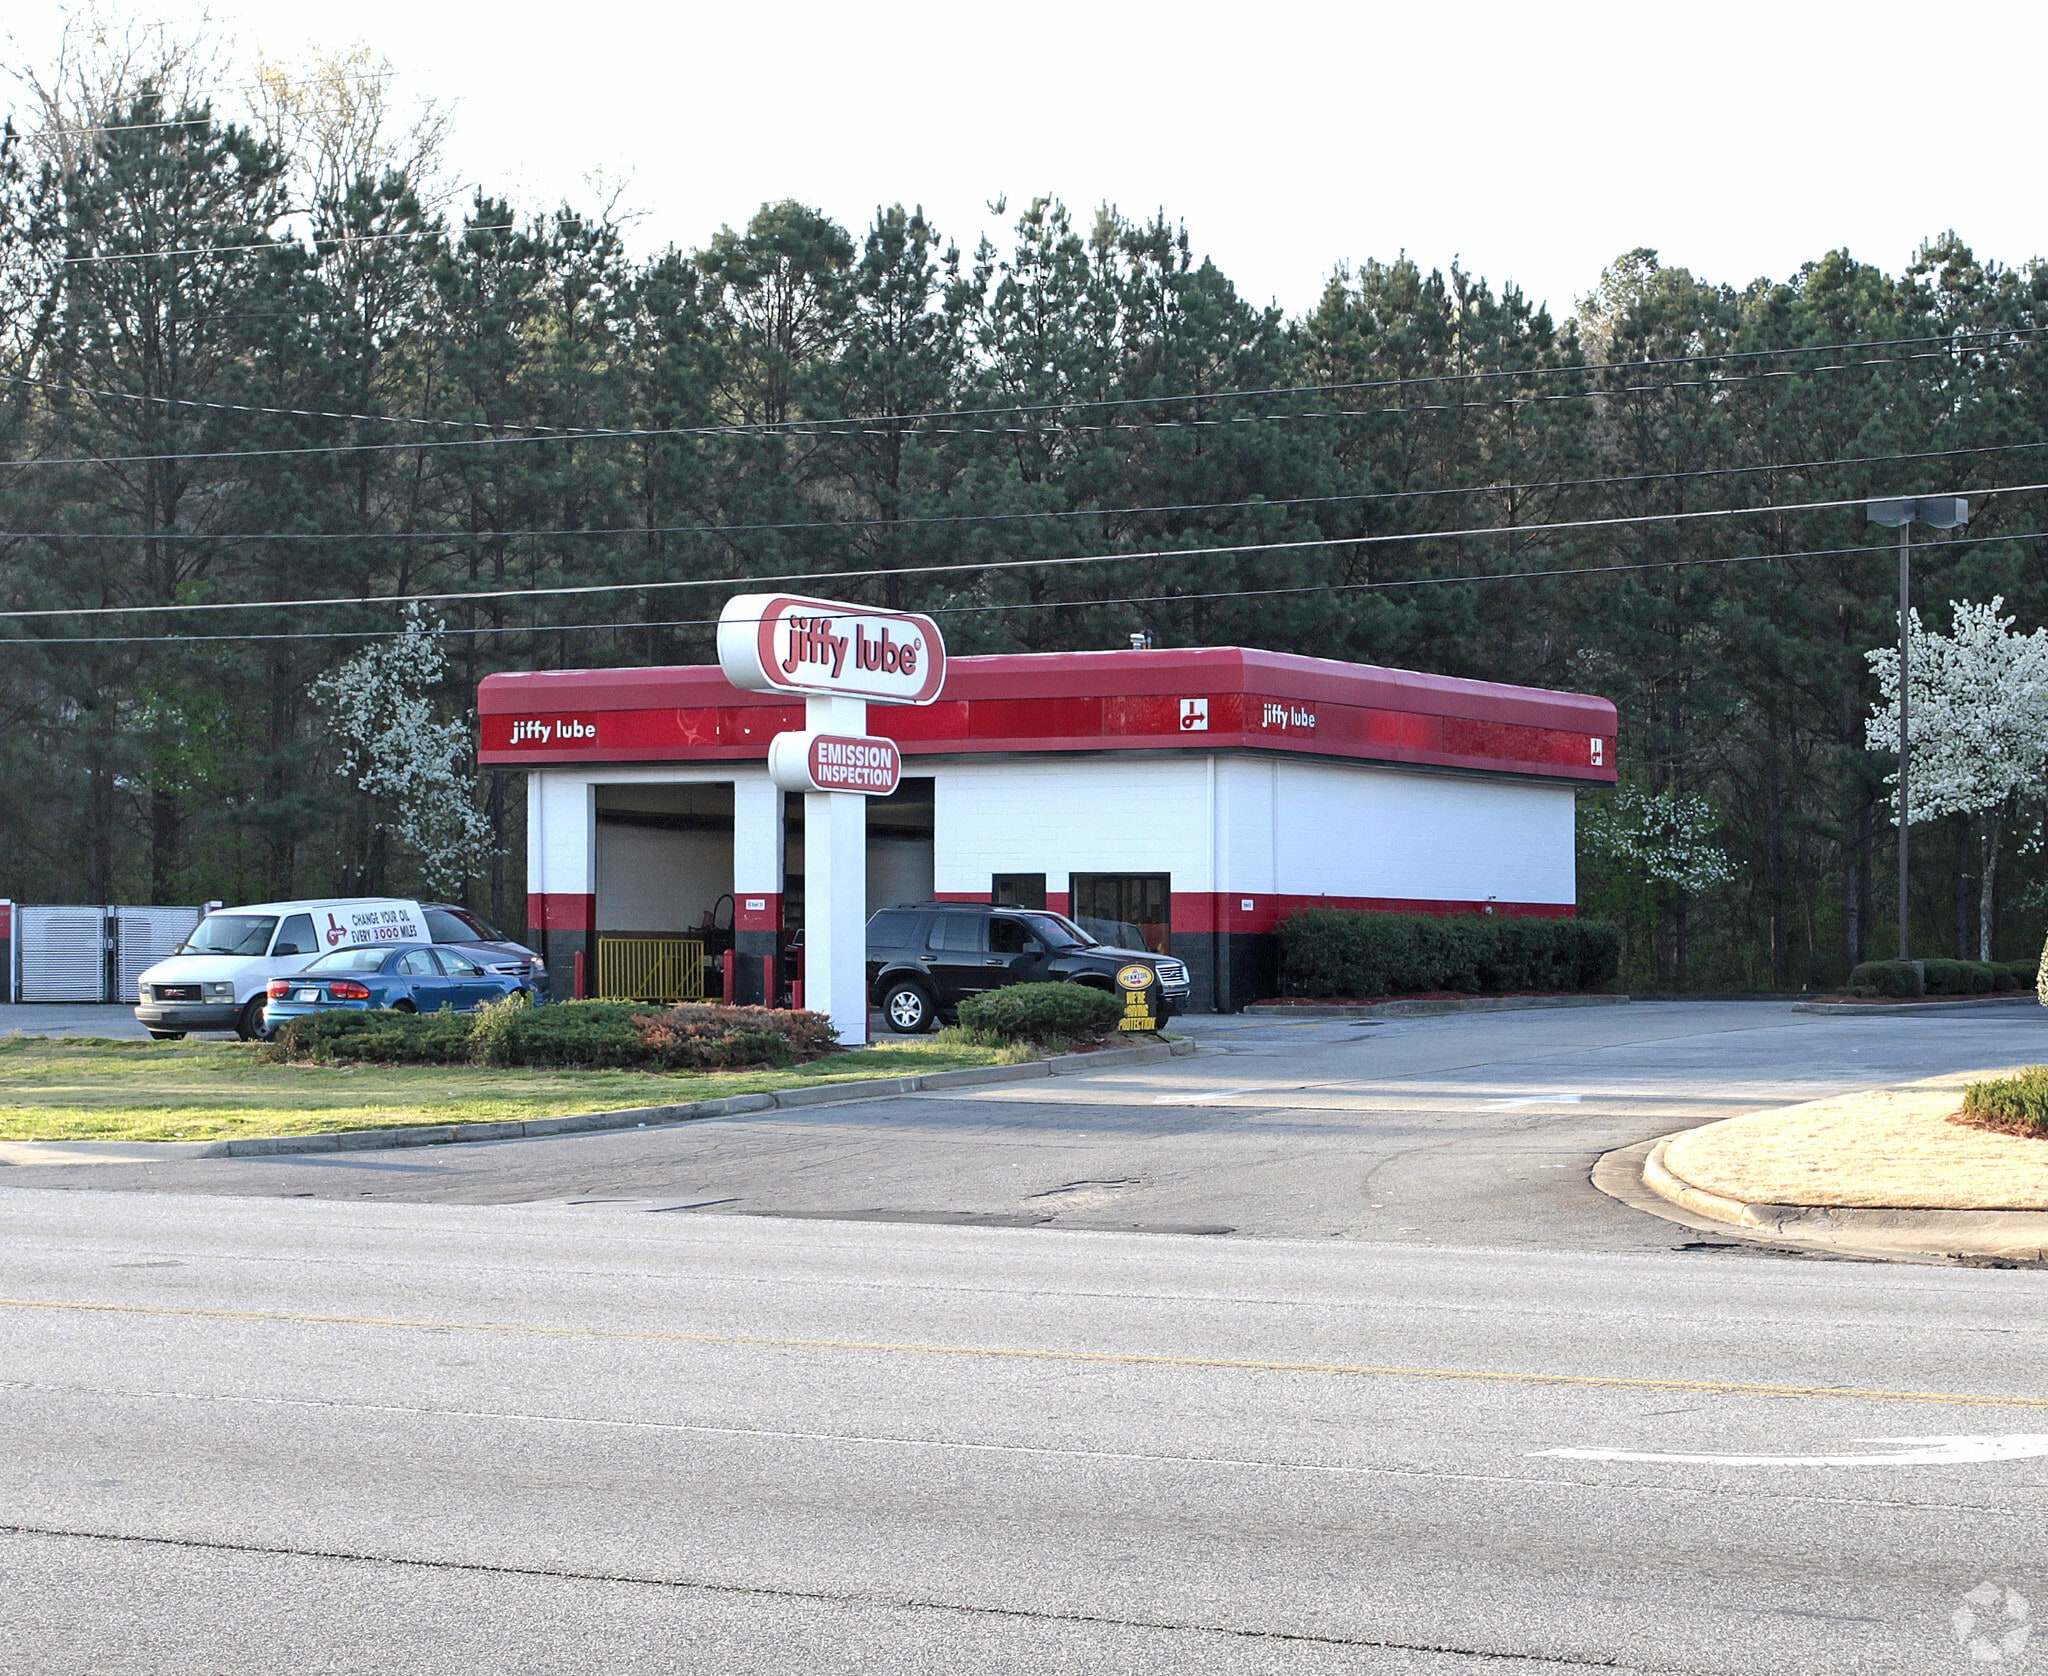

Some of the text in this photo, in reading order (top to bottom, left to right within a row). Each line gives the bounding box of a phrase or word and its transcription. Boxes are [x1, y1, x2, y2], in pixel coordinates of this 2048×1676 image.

[782, 614, 849, 679] jiffy
[1261, 703, 1316, 730] jiffy lube
[509, 719, 596, 744] jiffy lube
[818, 742, 892, 769] EMISSION
[818, 764, 892, 786] INSPECTION
[352, 909, 411, 927] CHANGE YOUR OIL
[351, 929, 371, 943] EVERY
[373, 927, 399, 940] 3000
[400, 924, 417, 938] MILES
